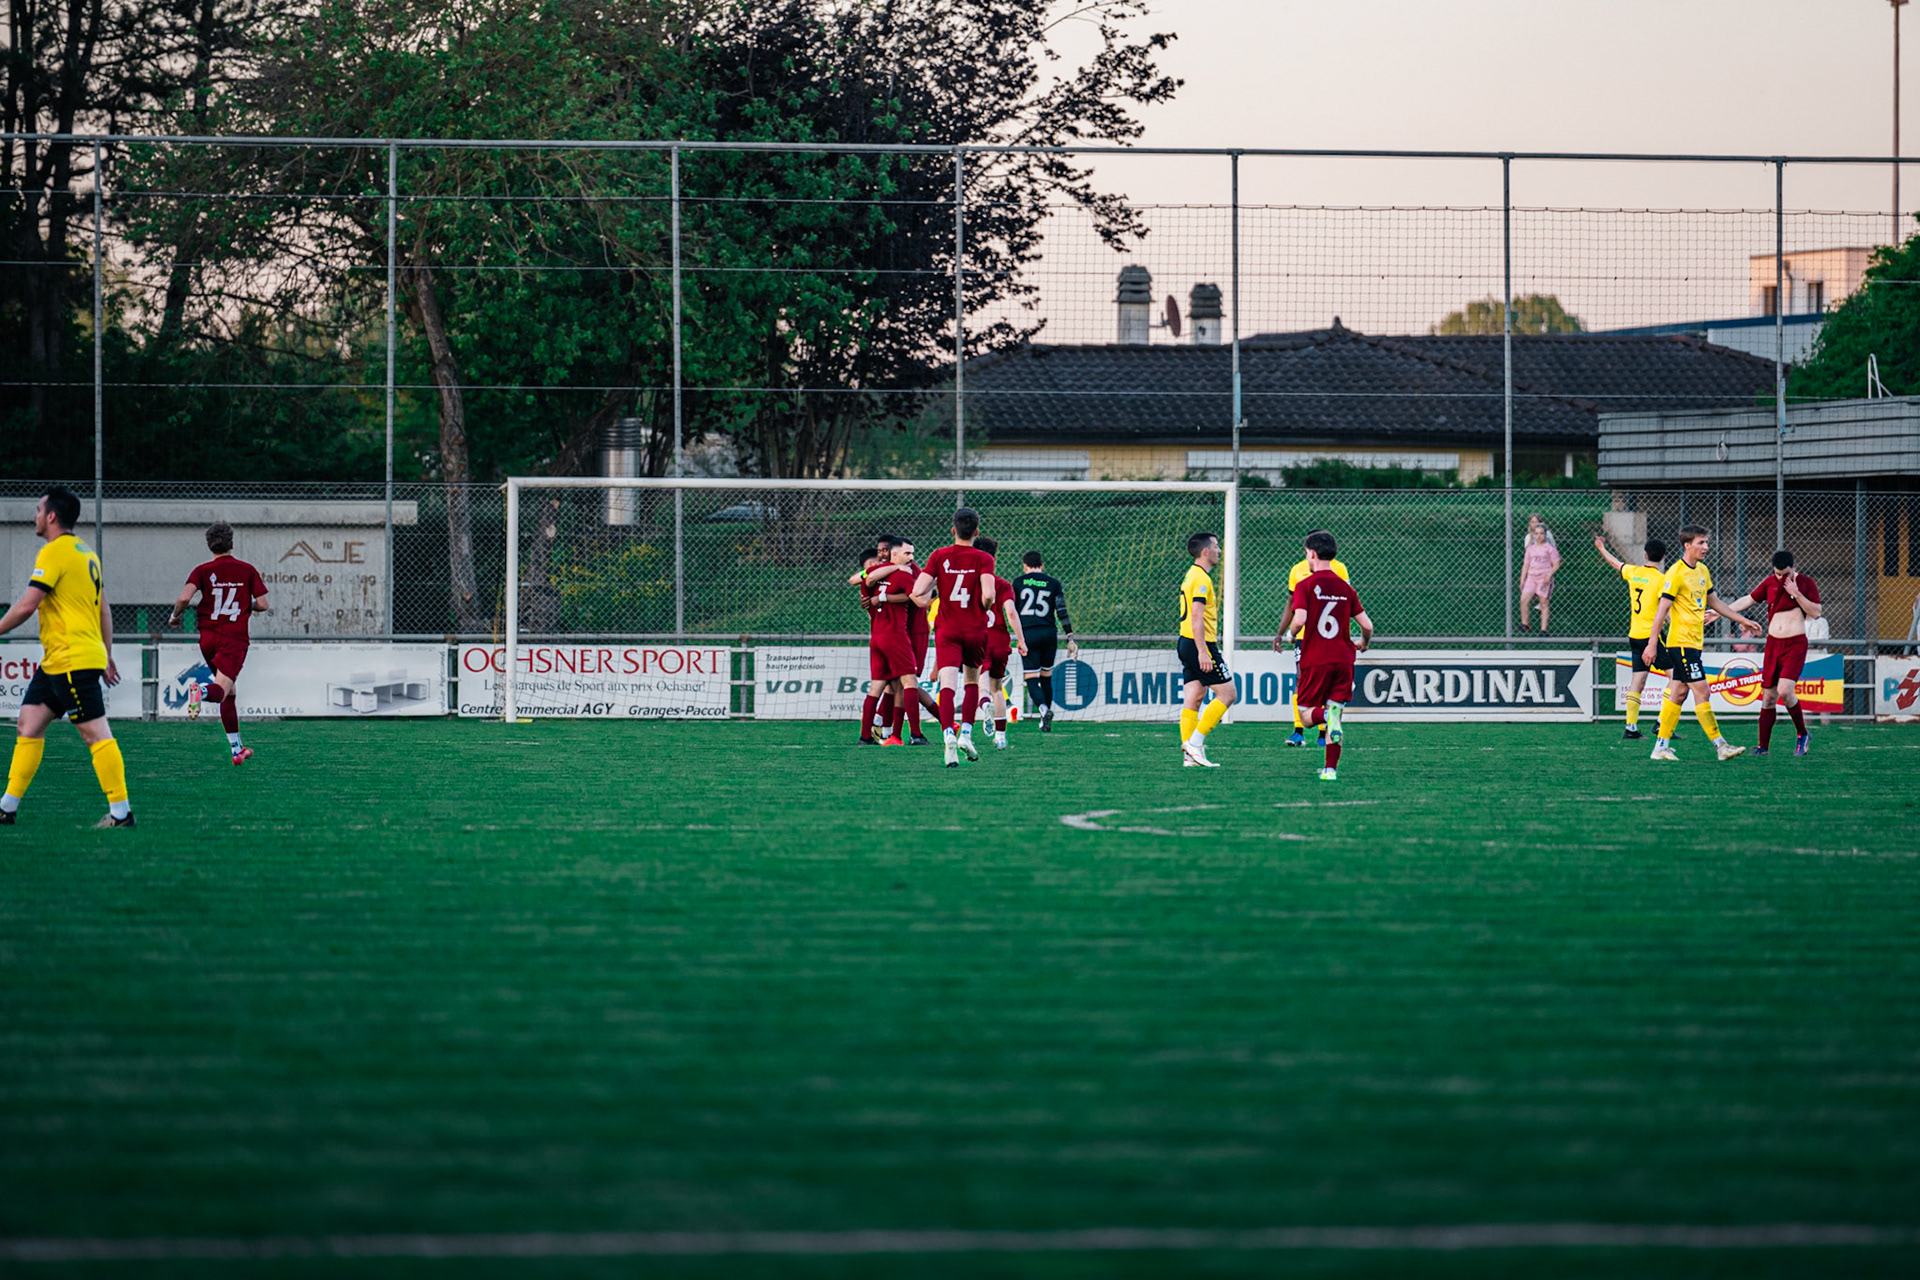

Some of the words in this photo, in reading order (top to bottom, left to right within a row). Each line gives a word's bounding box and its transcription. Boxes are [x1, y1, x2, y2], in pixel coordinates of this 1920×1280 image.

[260, 572, 298, 584] tation
[949, 574, 971, 608] 4
[210, 587, 242, 622] 14
[1020, 587, 1051, 617] 25
[1634, 587, 1644, 614] 3
[1317, 601, 1340, 639] 6
[622, 648, 726, 675] SPORT
[1690, 663, 1700, 672] 15
[10, 684, 28, 697] Cr
[557, 680, 572, 691] de
[574, 679, 605, 693] Sport
[607, 682, 628, 692] aux
[630, 680, 654, 694] prix
[765, 680, 824, 694] von
[1363, 668, 1565, 704] CARDINAL
[1710, 678, 1738, 692] COLOR
[1794, 677, 1825, 695] storf
[581, 702, 615, 715] AGY
[628, 704, 728, 718] Granges-Paccot
